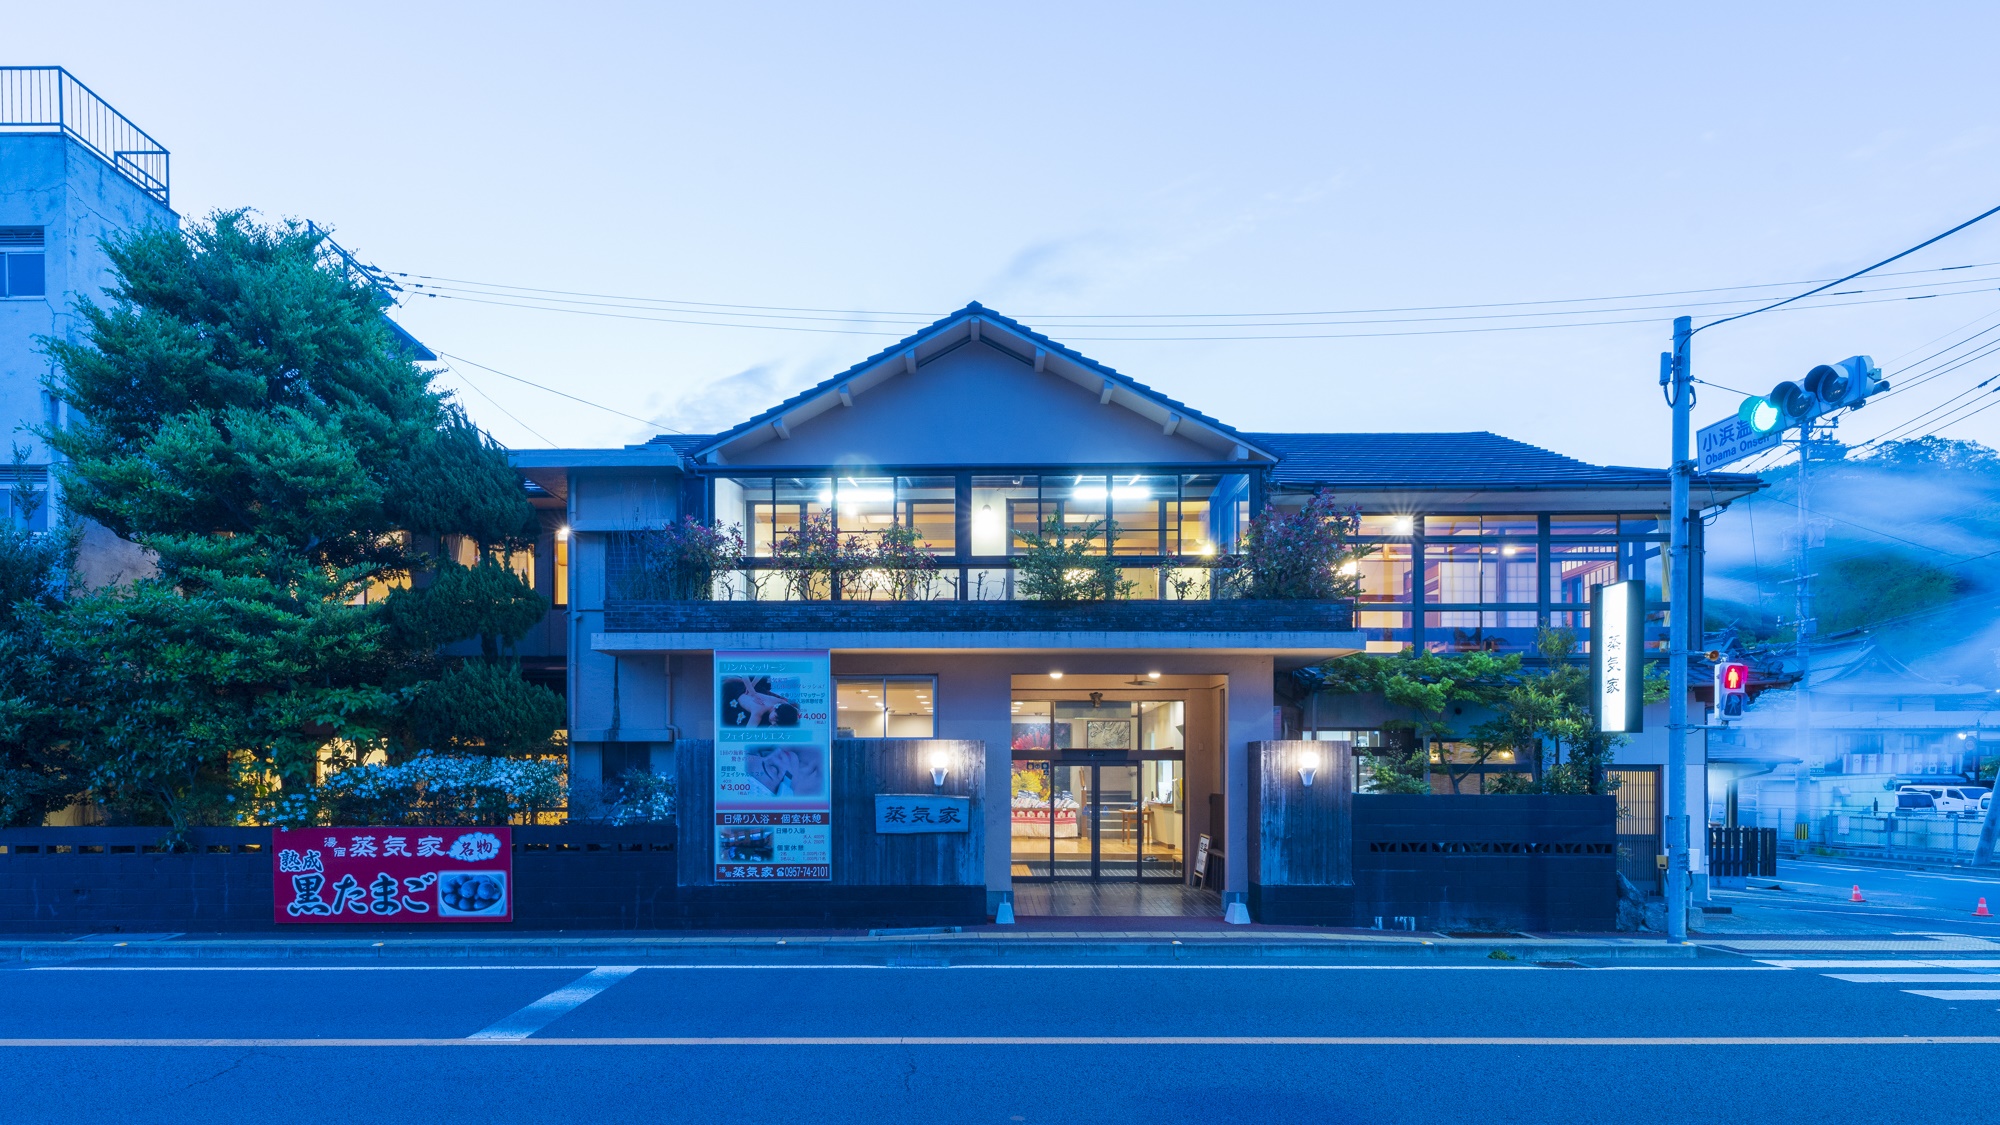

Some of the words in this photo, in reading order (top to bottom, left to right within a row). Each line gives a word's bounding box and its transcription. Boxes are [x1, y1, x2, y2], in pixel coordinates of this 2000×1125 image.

[1705, 447, 1737, 465] Obama
[1739, 435, 1770, 452] Onsen
[1606, 634, 1621, 694] 蒸気家
[724, 732, 793, 740] フェイシャルエステ
[724, 814, 822, 824] 日帰り入浴・個室休憩
[884, 806, 961, 824] 蒸気家
[349, 836, 445, 858] 蒸気家
[461, 840, 494, 856] 名物
[279, 850, 323, 872] 熟成
[732, 866, 775, 878] 蒸気家
[784, 867, 828, 877] 0957-74-2101
[287, 871, 437, 916] 黒たまご
